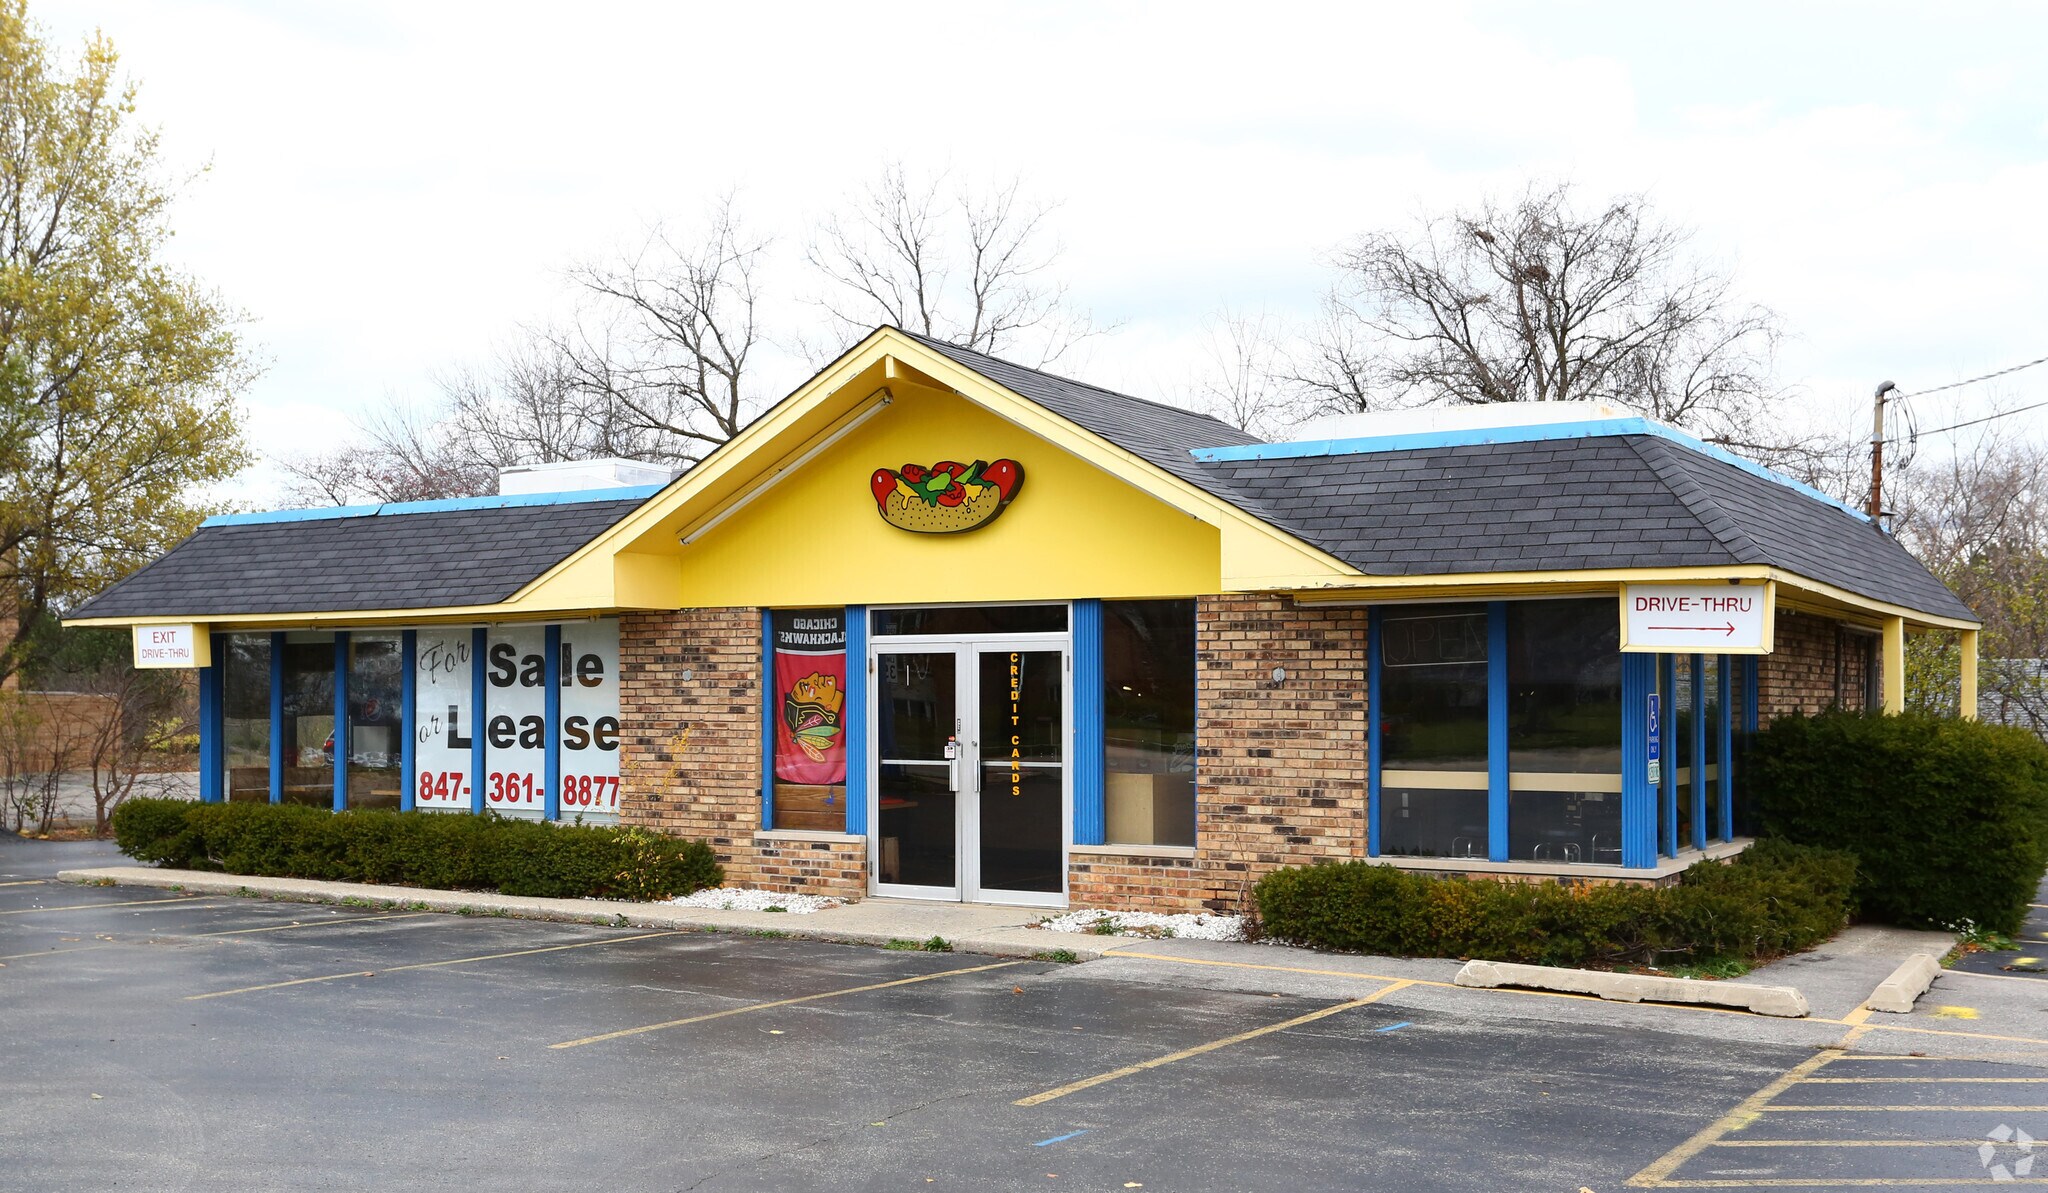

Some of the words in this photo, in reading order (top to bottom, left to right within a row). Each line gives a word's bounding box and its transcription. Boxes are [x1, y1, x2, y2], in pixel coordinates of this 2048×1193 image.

[1635, 597, 1752, 612] DRIVE-THRU
[142, 648, 189, 658] DRIVE-THRU
[152, 631, 176, 643] EXIT
[419, 640, 470, 684] For
[488, 643, 604, 687] Sale
[1010, 653, 1019, 726] CREDIT
[419, 715, 443, 743] or
[448, 705, 620, 751] Lease
[1011, 735, 1020, 796] CARDS
